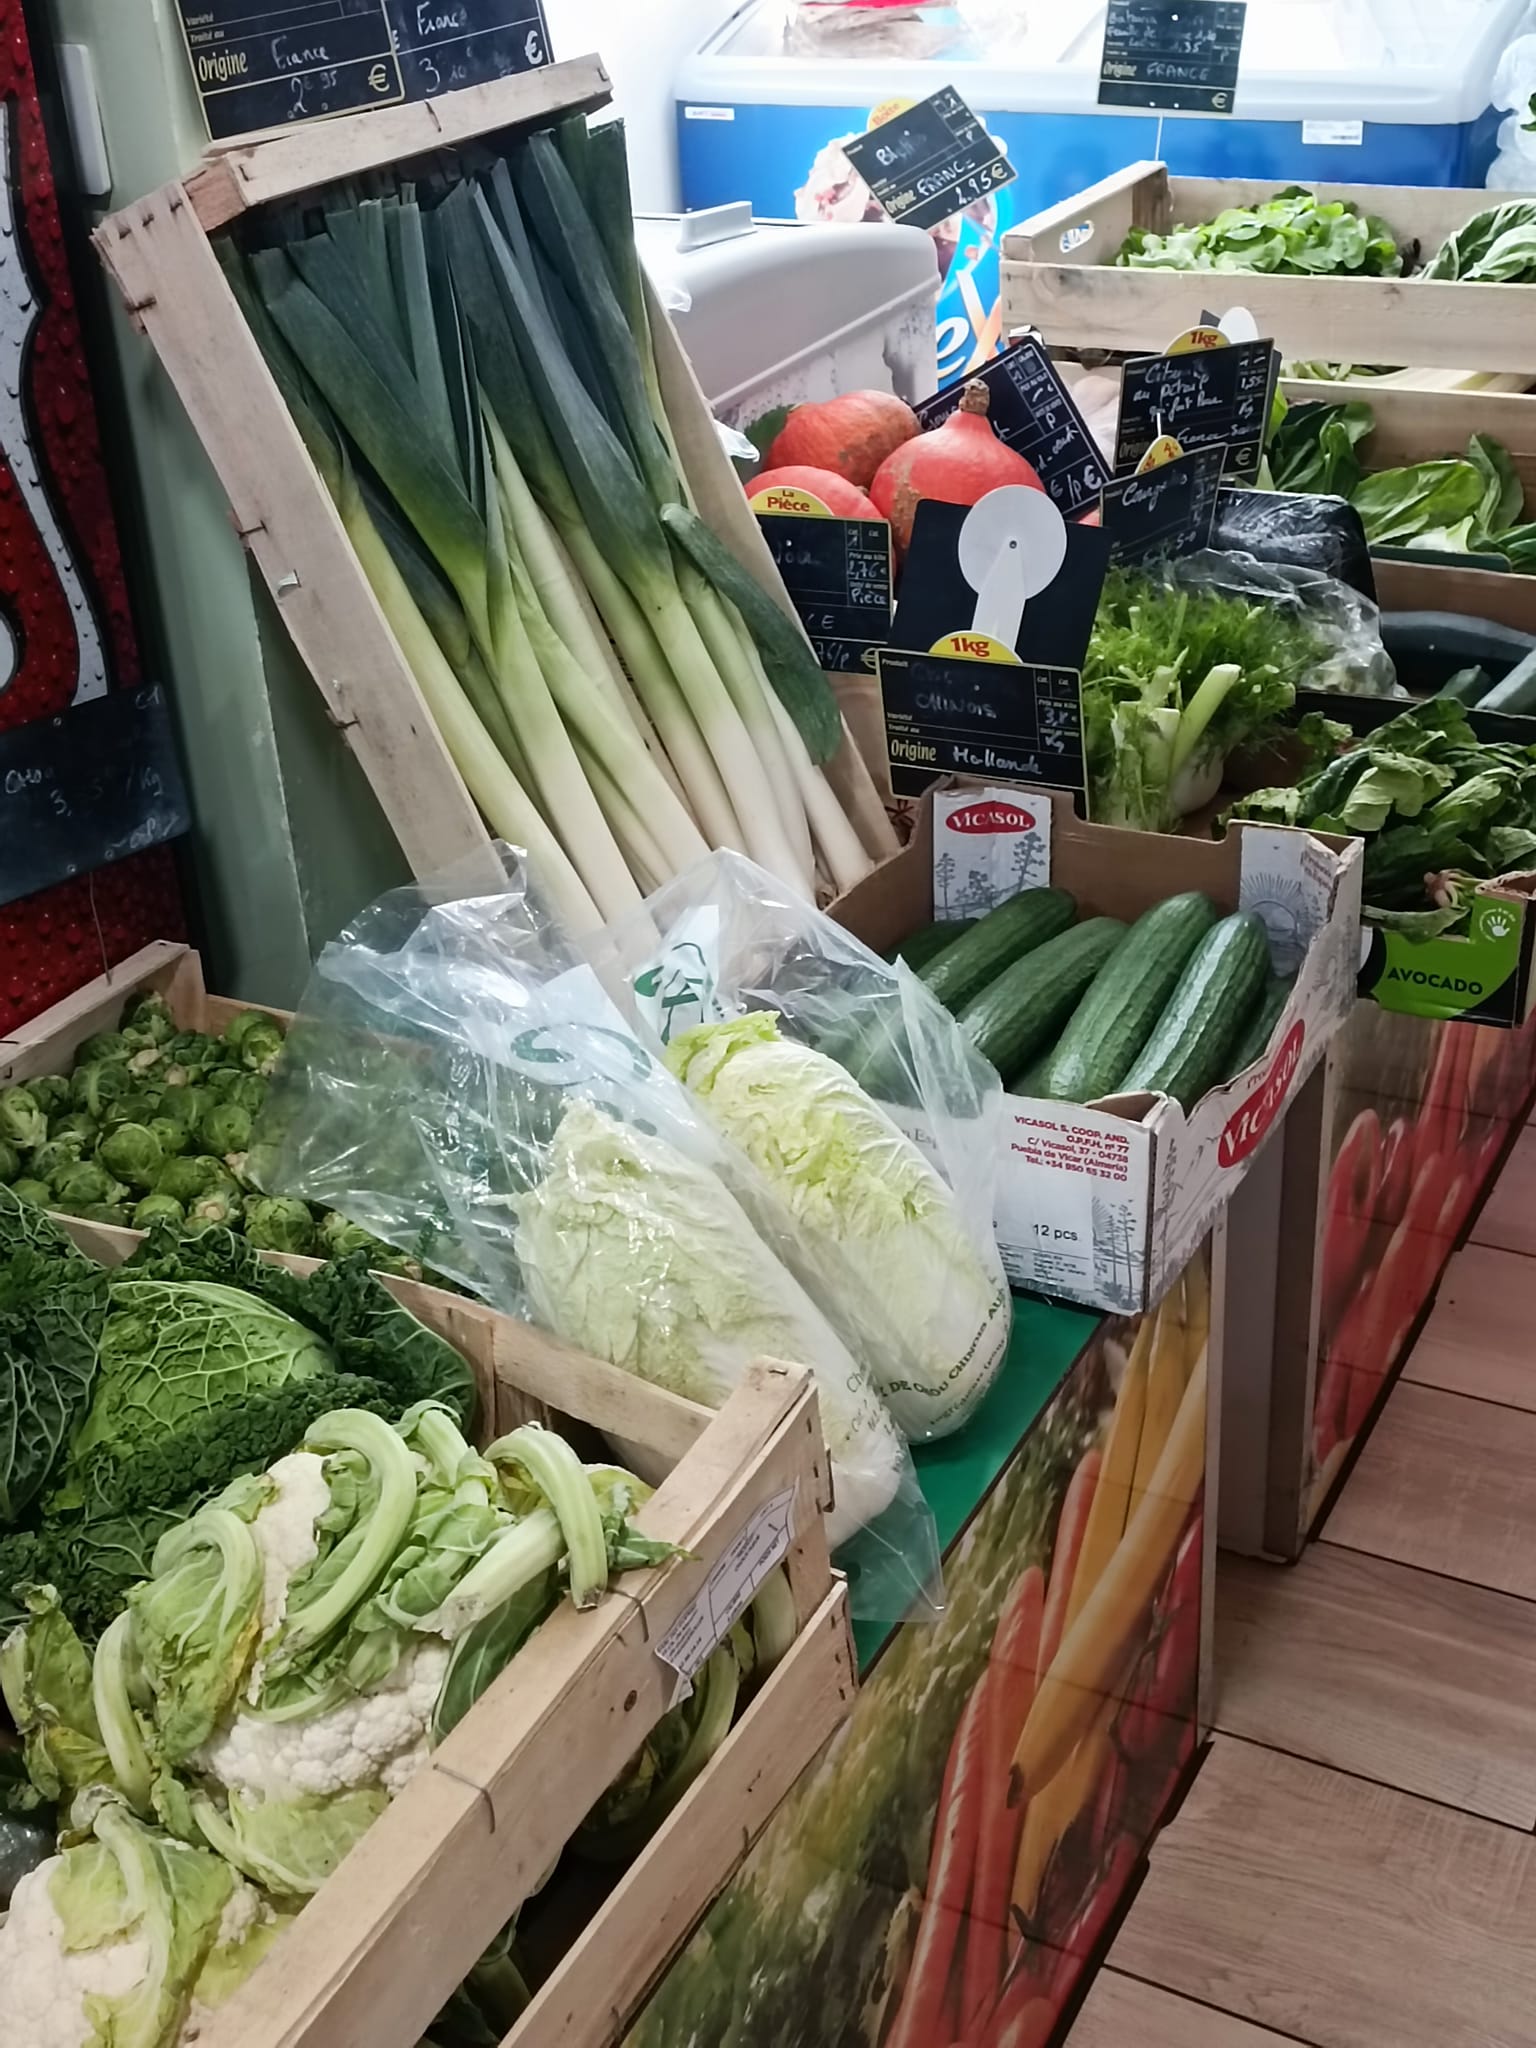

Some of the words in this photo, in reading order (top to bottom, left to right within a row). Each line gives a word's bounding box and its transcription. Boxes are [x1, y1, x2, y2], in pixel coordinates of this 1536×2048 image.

[524, 30, 543, 65] €
[198, 49, 249, 82] Origine
[1146, 62, 1212, 81] FRANCE
[368, 63, 390, 92] €
[1211, 91, 1228, 109] €
[990, 162, 1009, 180] €
[885, 189, 917, 214] Origine
[1190, 331, 1218, 348] 1kg
[1234, 448, 1252, 466] €
[1083, 465, 1101, 490] €
[767, 496, 810, 512] Pièce
[782, 490, 794, 498] La
[950, 637, 990, 657] 1kg
[891, 738, 937, 762] Origine
[1387, 966, 1484, 996] AVOCADO
[1014, 1115, 1058, 1131] VICASOL
[1060, 1124, 1069, 1133] S.
[1071, 1126, 1101, 1139] COOP.
[1104, 1133, 1130, 1144] AND.
[1010, 1143, 1042, 1156] Puebla
[1044, 1149, 1056, 1158] de
[1027, 1137, 1039, 1146] C/
[1078, 1146, 1090, 1155] 37
[1098, 1150, 1129, 1163] 04738
[1066, 1135, 1102, 1149] O.P.F.H.
[1117, 1144, 1129, 1153] 77
[1045, 1159, 1063, 1169] +34
[1065, 1162, 1084, 1173] 950
[1100, 1169, 1111, 1179] 32
[1113, 1172, 1127, 1182] 00
[1032, 1223, 1050, 1237] 12
[1053, 1229, 1079, 1241] pcs
